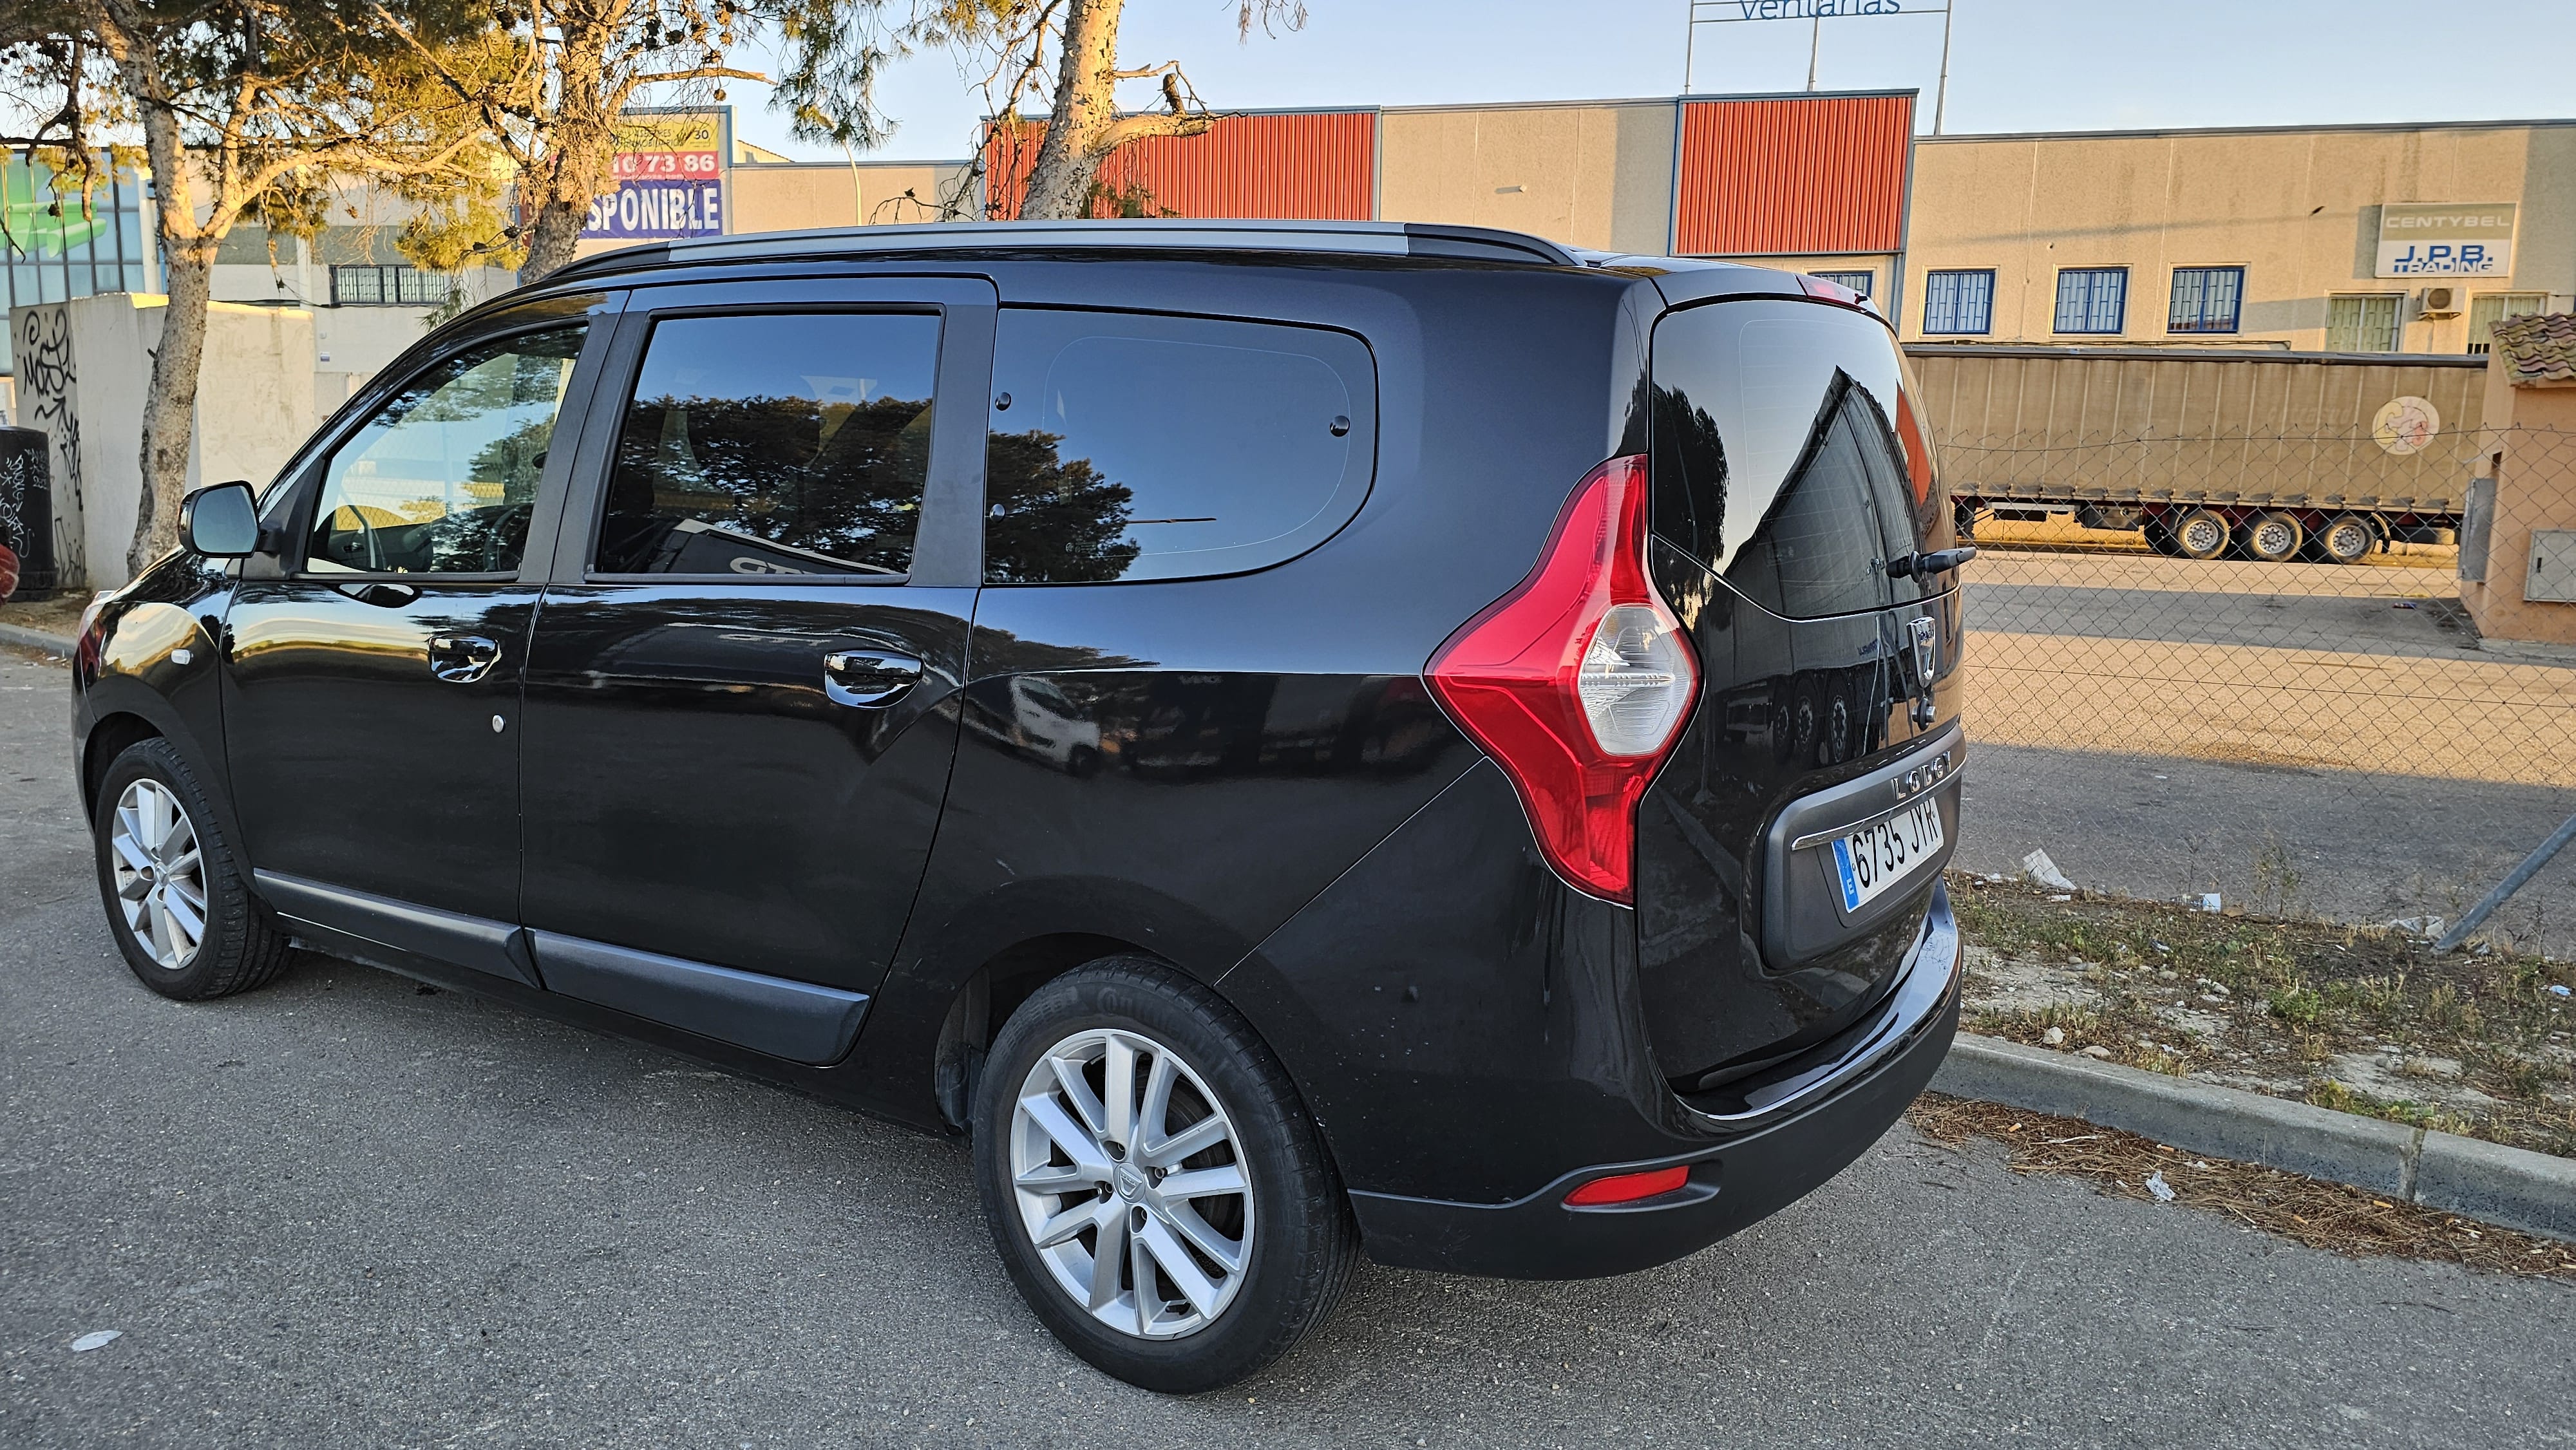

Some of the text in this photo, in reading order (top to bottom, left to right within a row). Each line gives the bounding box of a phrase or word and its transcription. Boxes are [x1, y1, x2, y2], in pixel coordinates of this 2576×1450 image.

[645, 155, 676, 173] 73
[684, 154, 715, 172] 86
[582, 187, 720, 232] SPONIBLE
[2385, 215, 2510, 229] CENTYBEL
[2394, 245, 2494, 263] J.P.B.
[2392, 260, 2494, 274] TRADING
[730, 556, 818, 574] GT
[1891, 750, 1951, 800] LODGY
[1852, 821, 1905, 889] 6735
